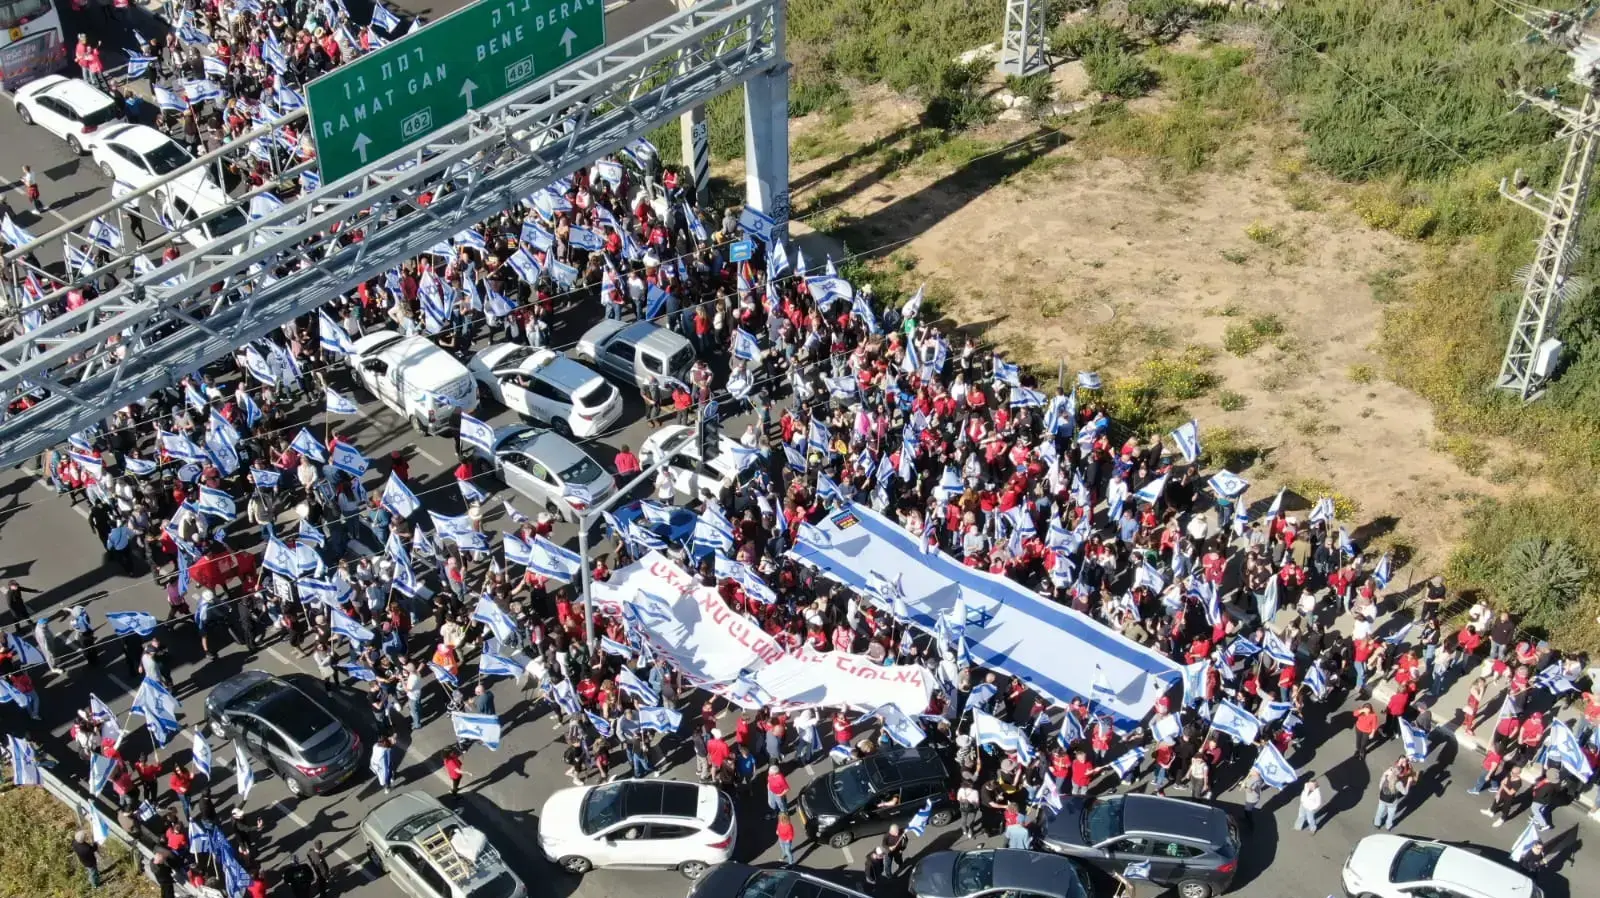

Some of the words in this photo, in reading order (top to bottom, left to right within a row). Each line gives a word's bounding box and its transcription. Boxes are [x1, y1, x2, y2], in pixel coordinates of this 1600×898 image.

[476, 25, 524, 62] BENE
[381, 47, 424, 81] רמת
[508, 61, 531, 82] 482
[322, 89, 394, 138] RAMAT
[408, 63, 447, 95] GAN
[344, 76, 366, 100] גן
[405, 112, 430, 133] 482
[700, 592, 731, 625] את
[836, 655, 922, 688] בישראל
